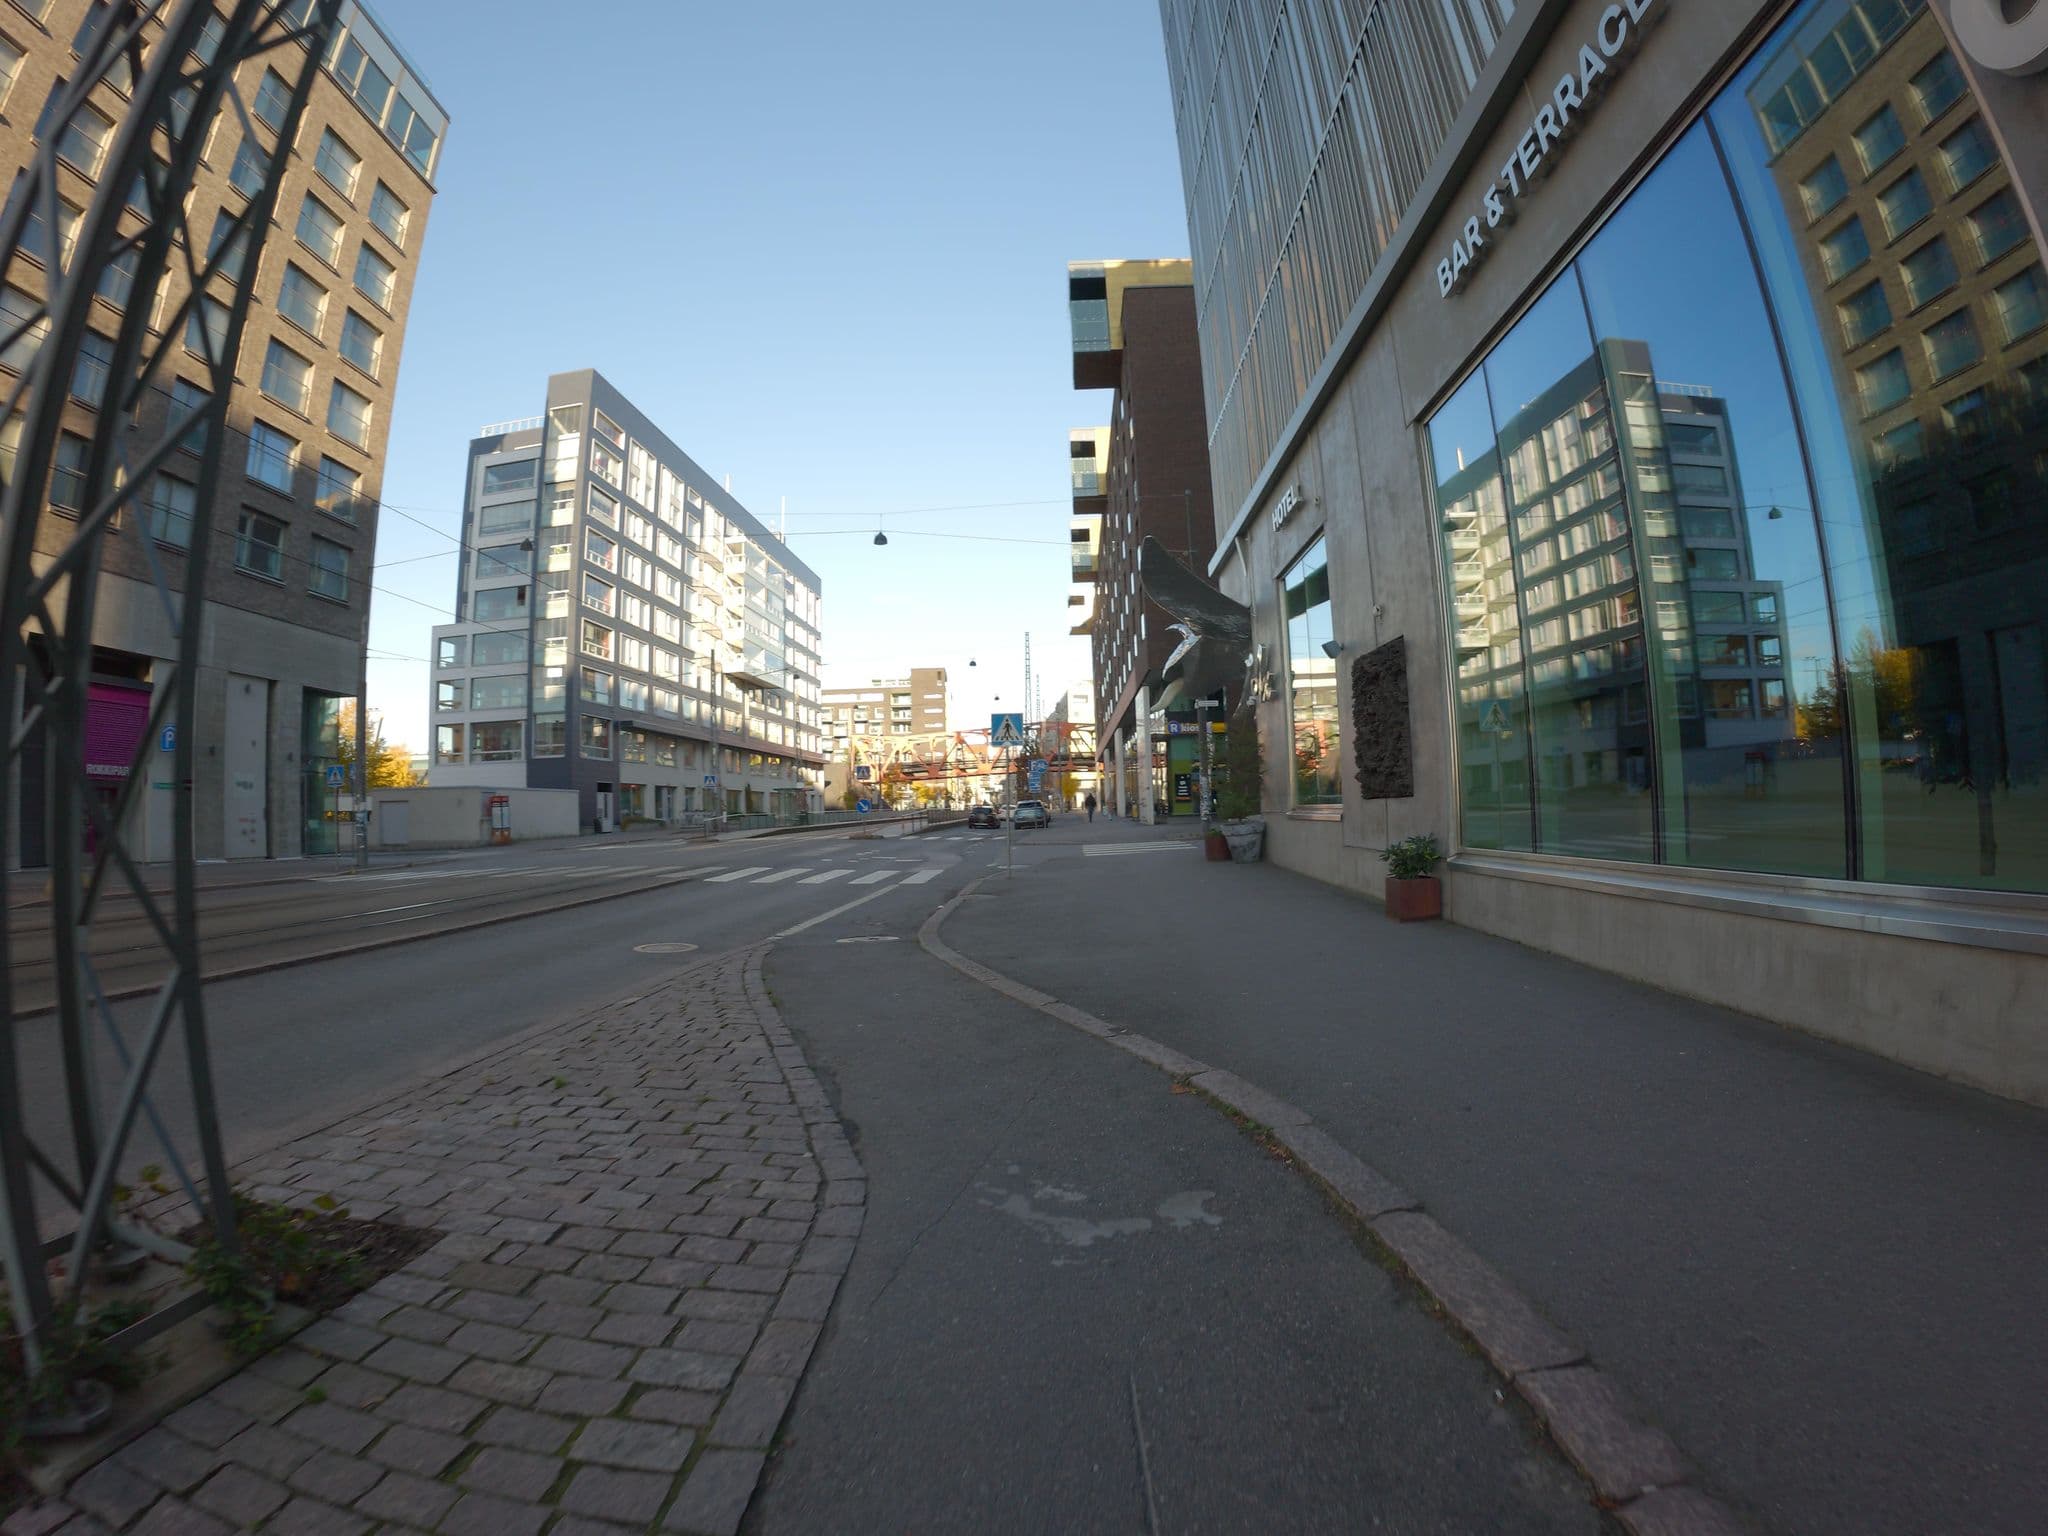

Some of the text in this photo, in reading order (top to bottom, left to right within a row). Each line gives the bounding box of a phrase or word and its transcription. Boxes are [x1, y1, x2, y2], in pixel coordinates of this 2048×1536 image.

[1436, 215, 1484, 299] BAR
[1483, 183, 1505, 228] &
[1271, 485, 1298, 532] HOTEL
[1170, 723, 1178, 733] R
